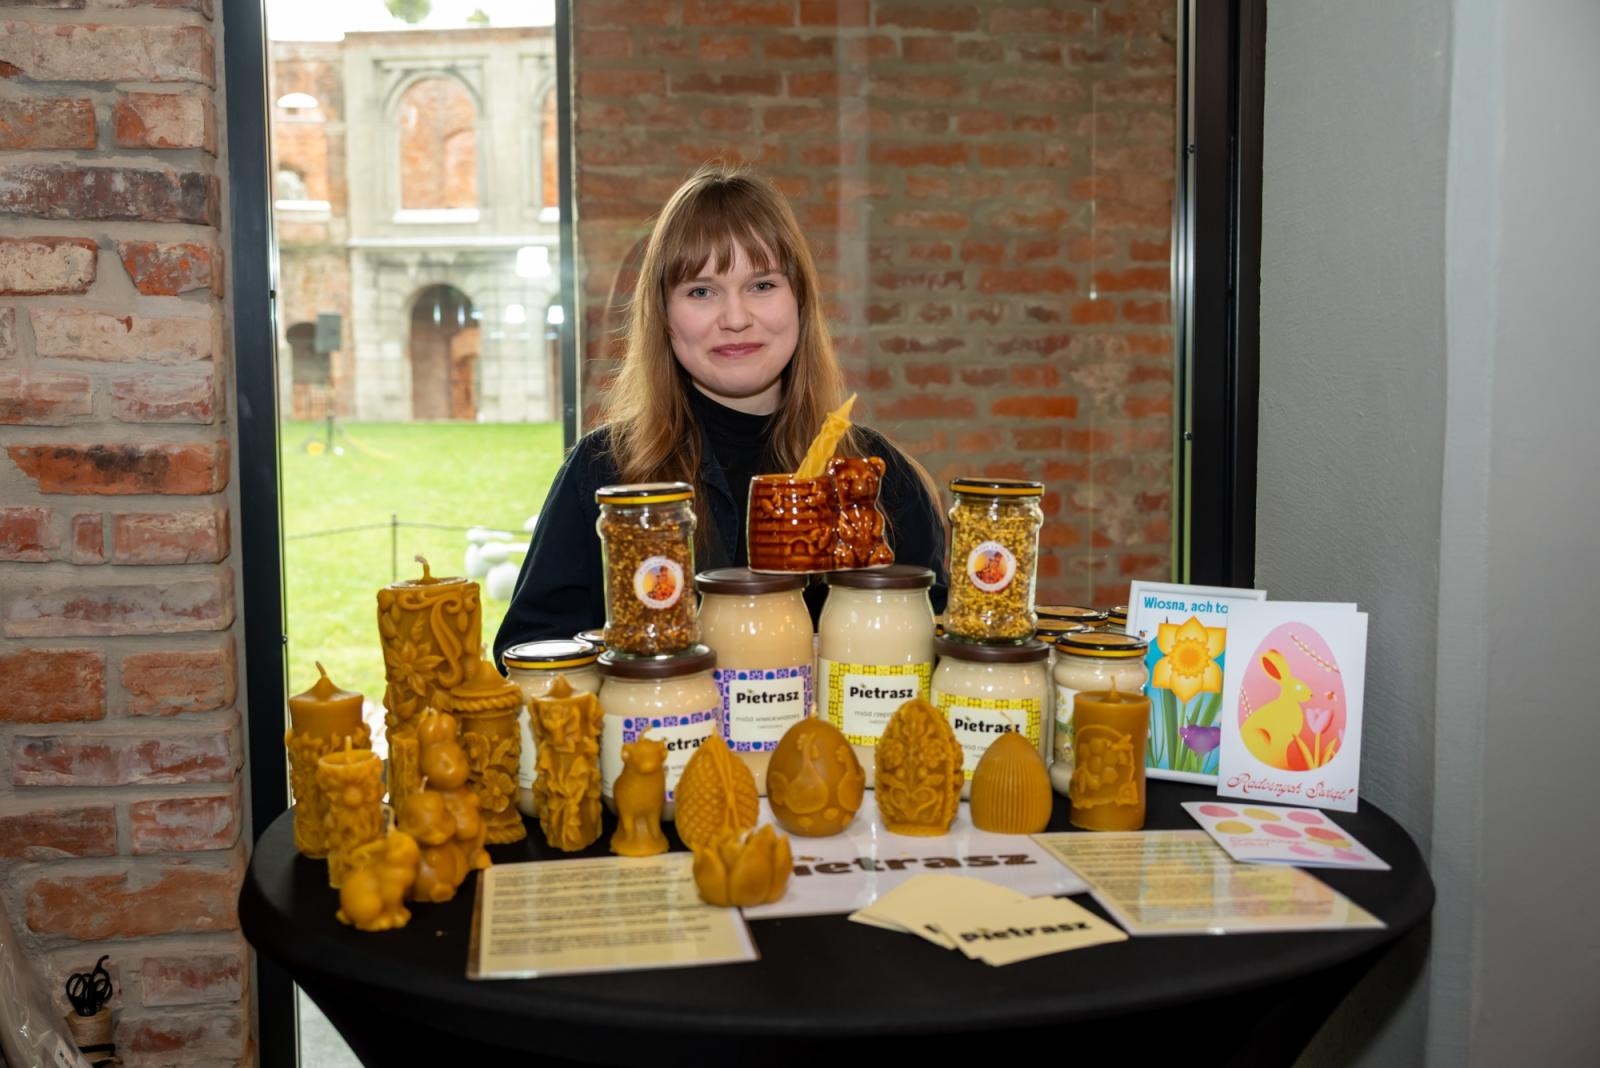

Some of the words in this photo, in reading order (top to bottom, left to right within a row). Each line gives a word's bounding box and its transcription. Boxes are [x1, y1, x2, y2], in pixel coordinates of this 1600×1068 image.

[1144, 596, 1188, 612] Wiosna,
[1191, 601, 1213, 613] ach
[736, 689, 800, 704] Pietrasz
[850, 683, 913, 699] Pietrasz
[793, 854, 1037, 876] ietrasz
[960, 921, 1091, 943] Pietrasz
